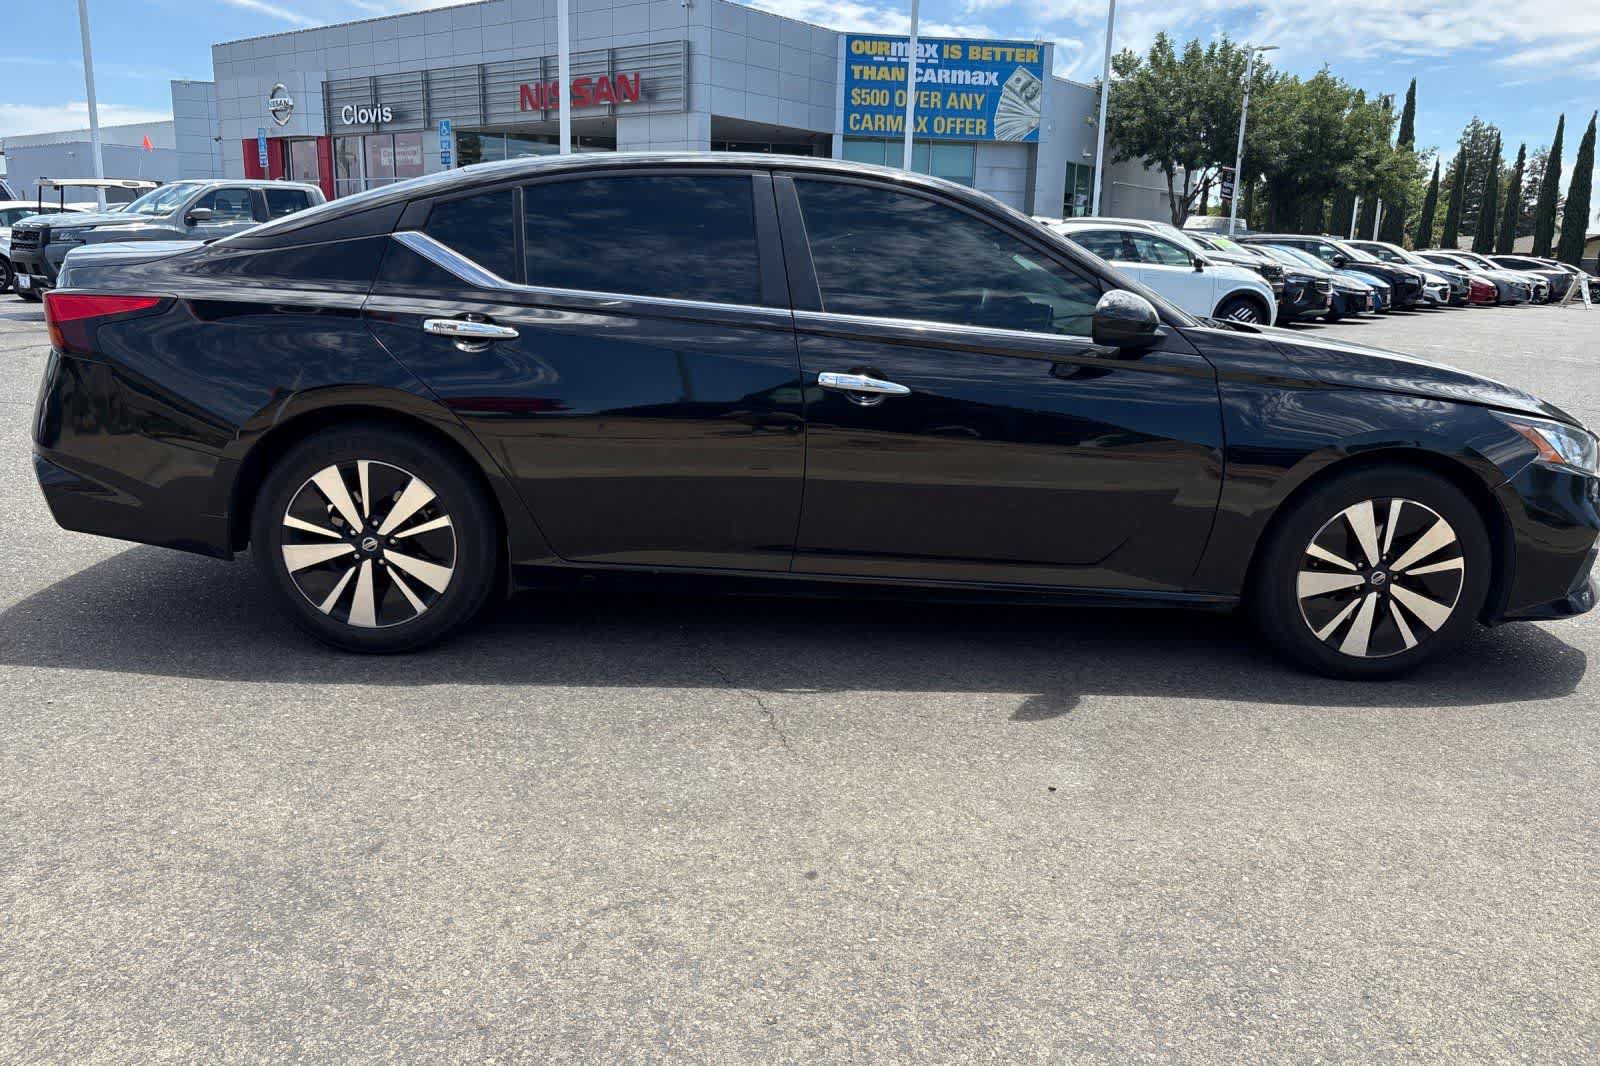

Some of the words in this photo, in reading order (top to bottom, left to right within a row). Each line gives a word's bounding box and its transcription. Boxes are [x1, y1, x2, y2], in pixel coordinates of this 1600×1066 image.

[851, 39, 938, 58] OURmax
[943, 45, 962, 59] IS
[968, 46, 1039, 63] BETTER
[851, 64, 905, 81] THAN
[915, 67, 999, 86] CARmax
[851, 87, 890, 107] $500
[946, 92, 985, 110] ANY
[341, 103, 393, 125] Clovis
[849, 113, 928, 133] CARMX
[933, 116, 987, 135] OFFER
